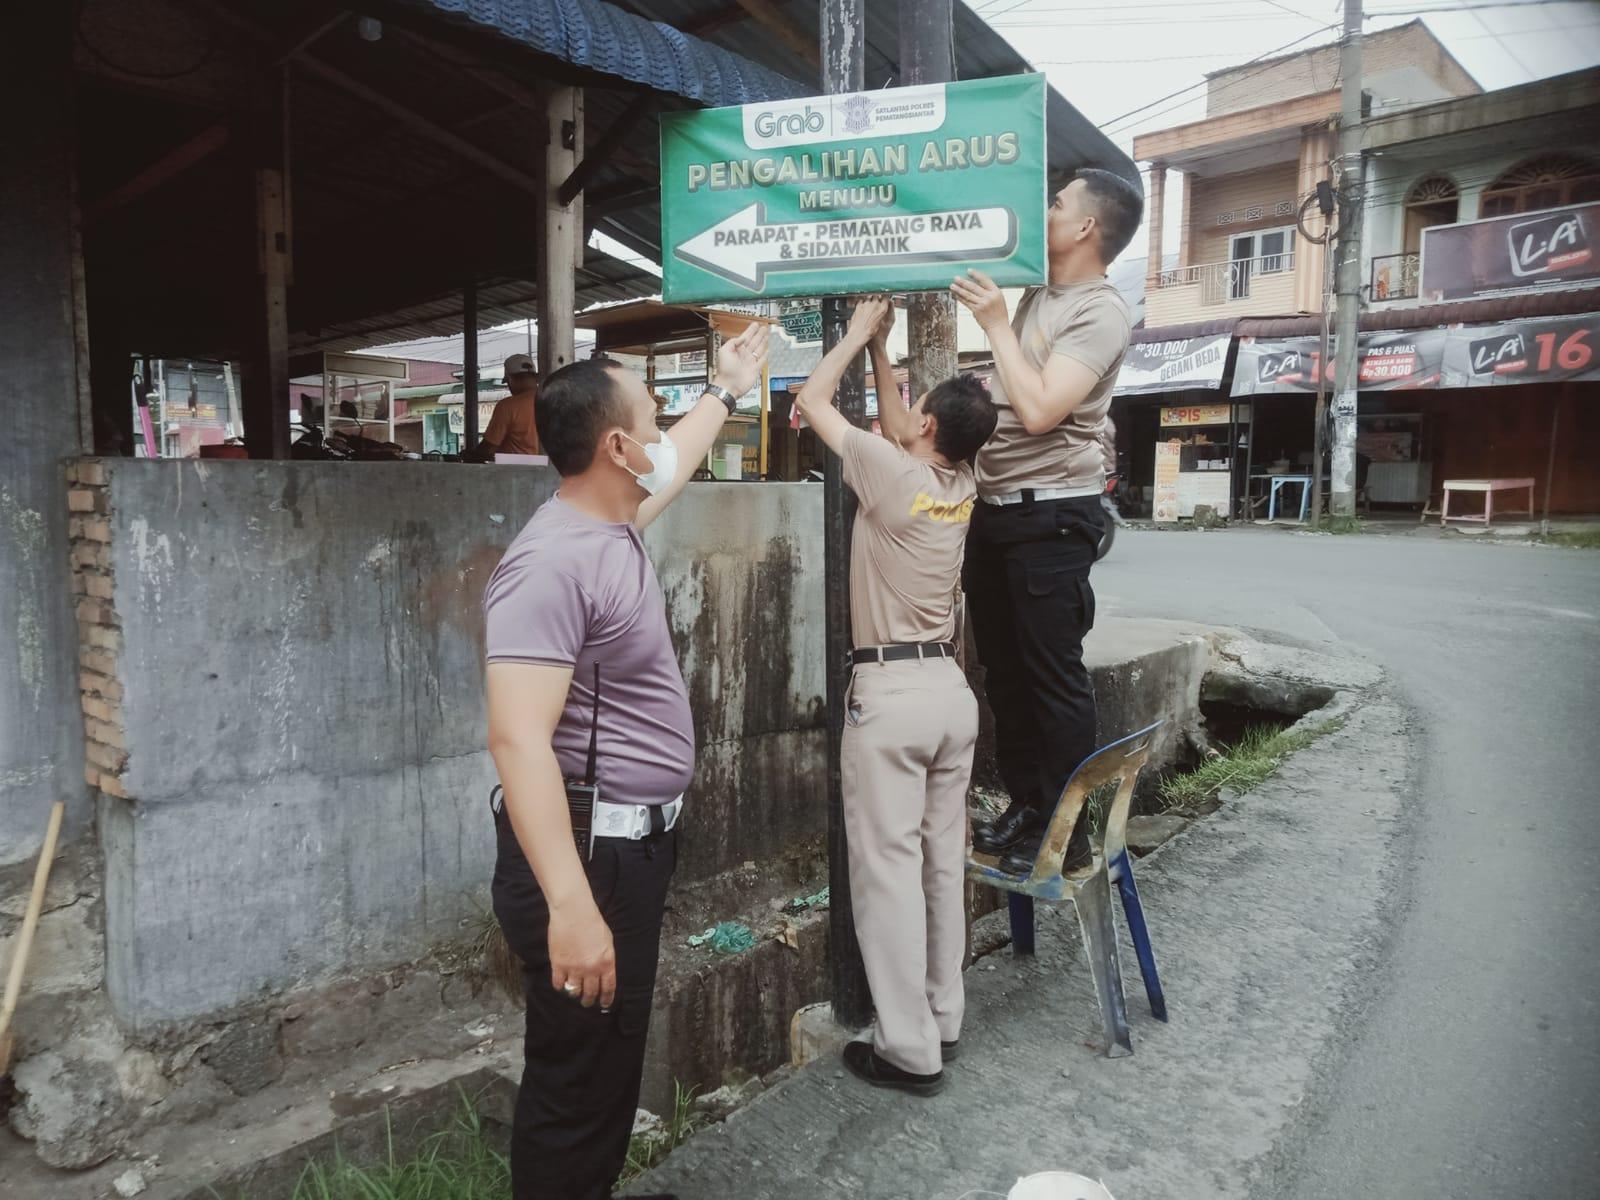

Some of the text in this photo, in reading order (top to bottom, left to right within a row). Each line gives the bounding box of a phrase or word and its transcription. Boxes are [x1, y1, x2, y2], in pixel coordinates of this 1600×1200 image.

[755, 105, 824, 138] Grab
[687, 132, 1019, 192] PENGALIHAN ARUS
[799, 184, 895, 210] MENUJU
[714, 226, 798, 247] PARAPAT
[816, 217, 926, 240] PEMATANG
[930, 212, 983, 233] RAYA
[780, 236, 912, 259] & SIDAMANIK
[1195, 346, 1221, 369] BEDA
[1536, 329, 1593, 371] 16
